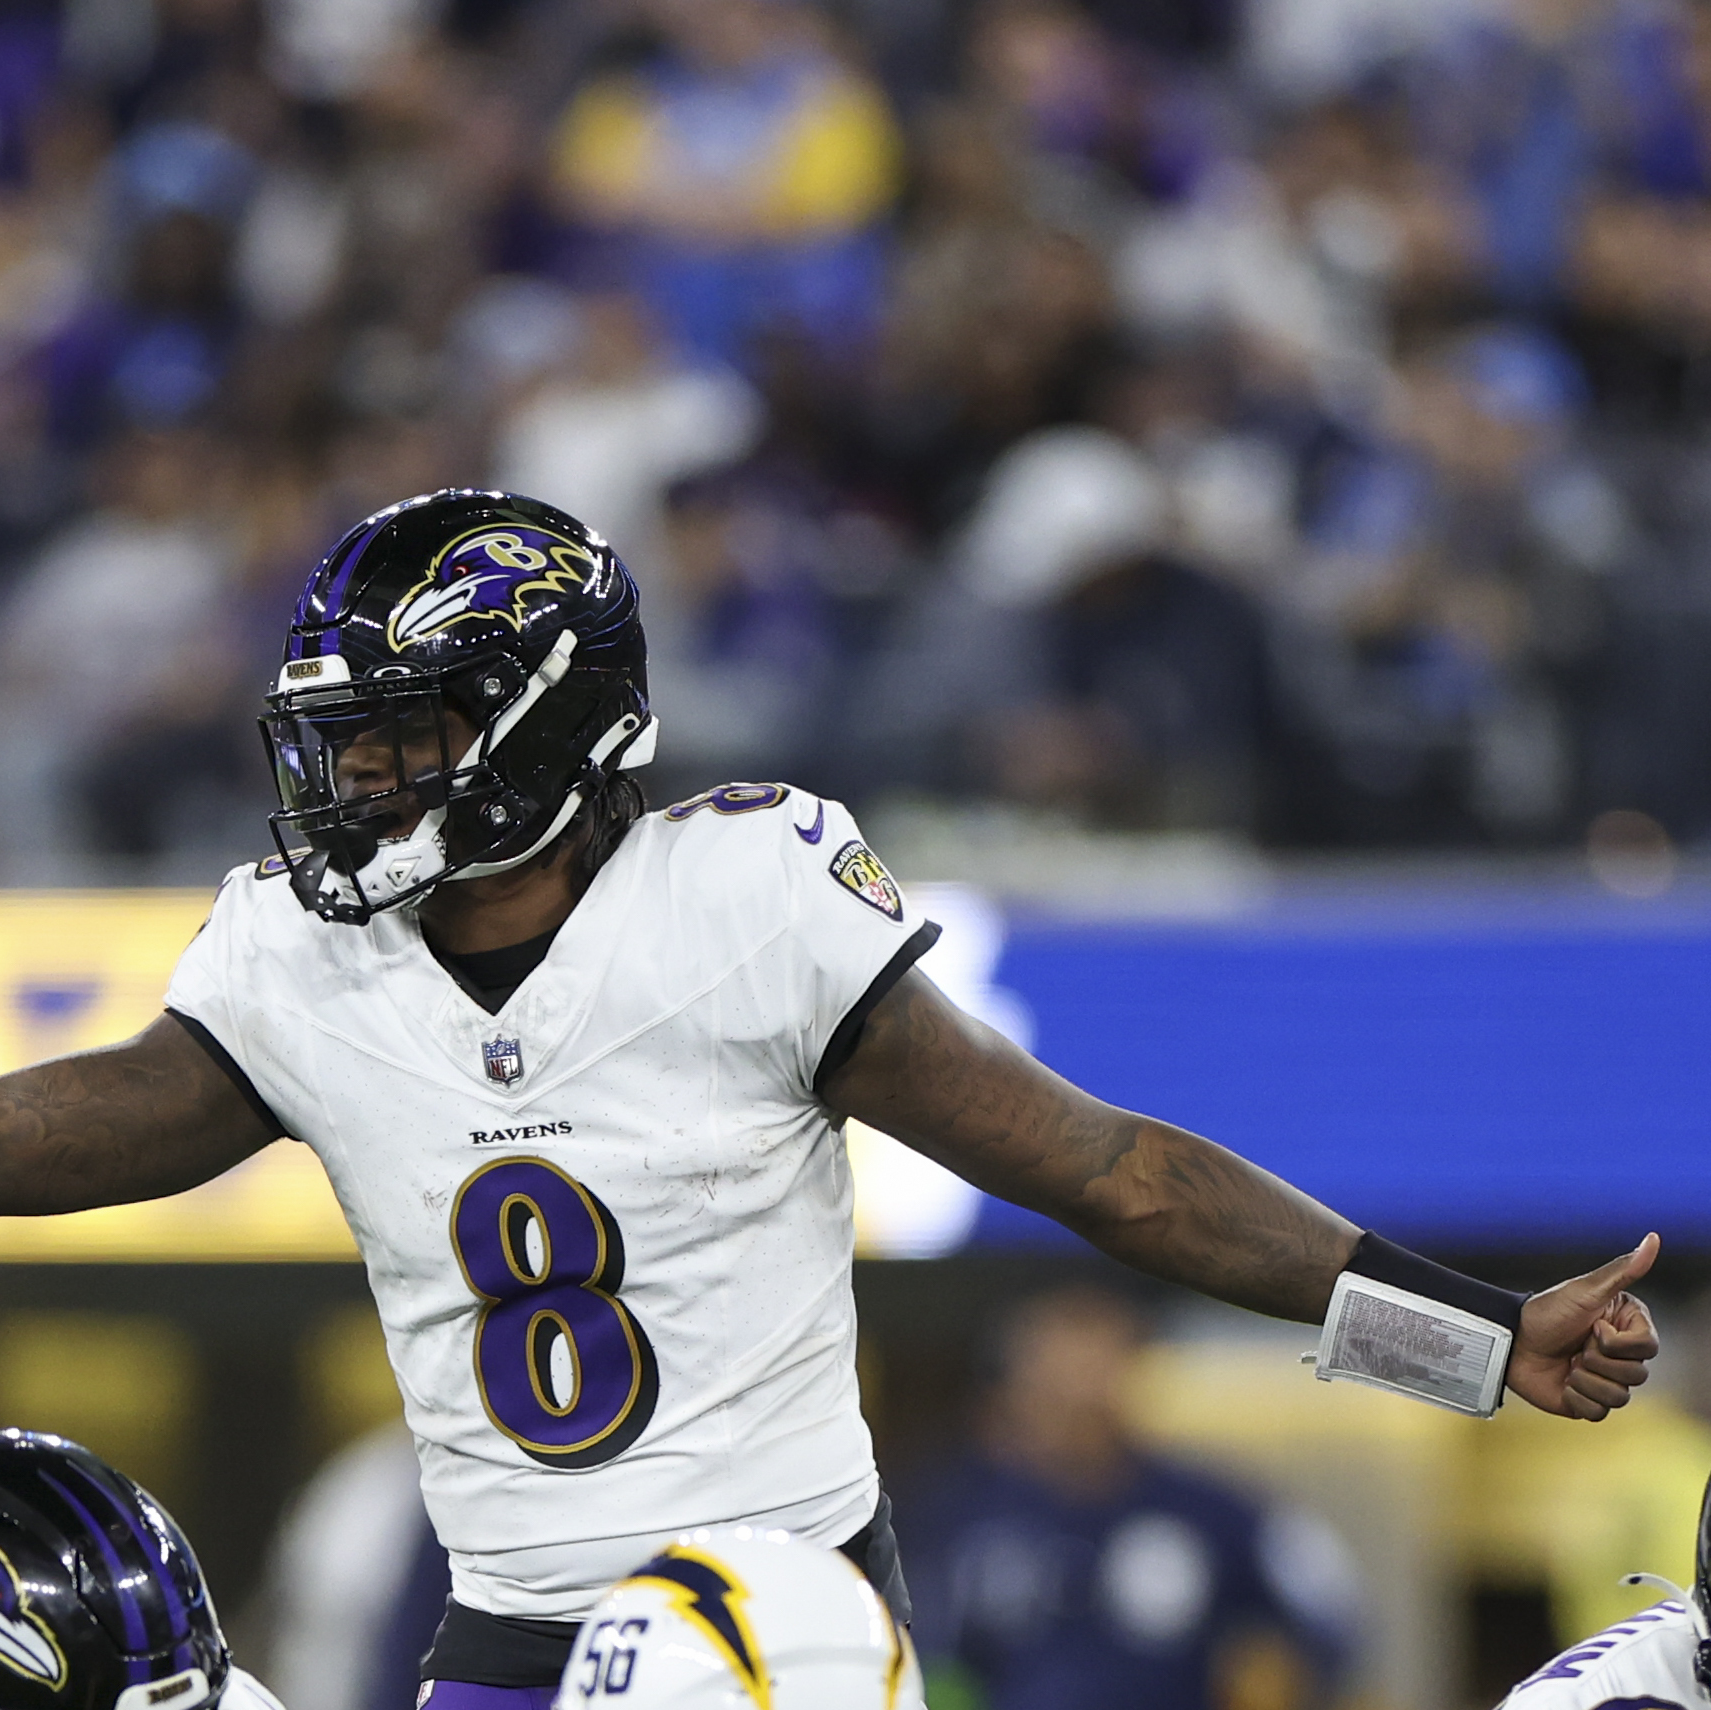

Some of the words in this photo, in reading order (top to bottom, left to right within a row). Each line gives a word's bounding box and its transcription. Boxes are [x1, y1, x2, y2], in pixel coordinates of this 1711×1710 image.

[832, 843, 865, 875] RAVENS
[489, 1056, 520, 1080] NFL
[468, 1121, 574, 1145] RAVENS
[449, 1155, 660, 1470] 8
[578, 1617, 651, 1698] 56
